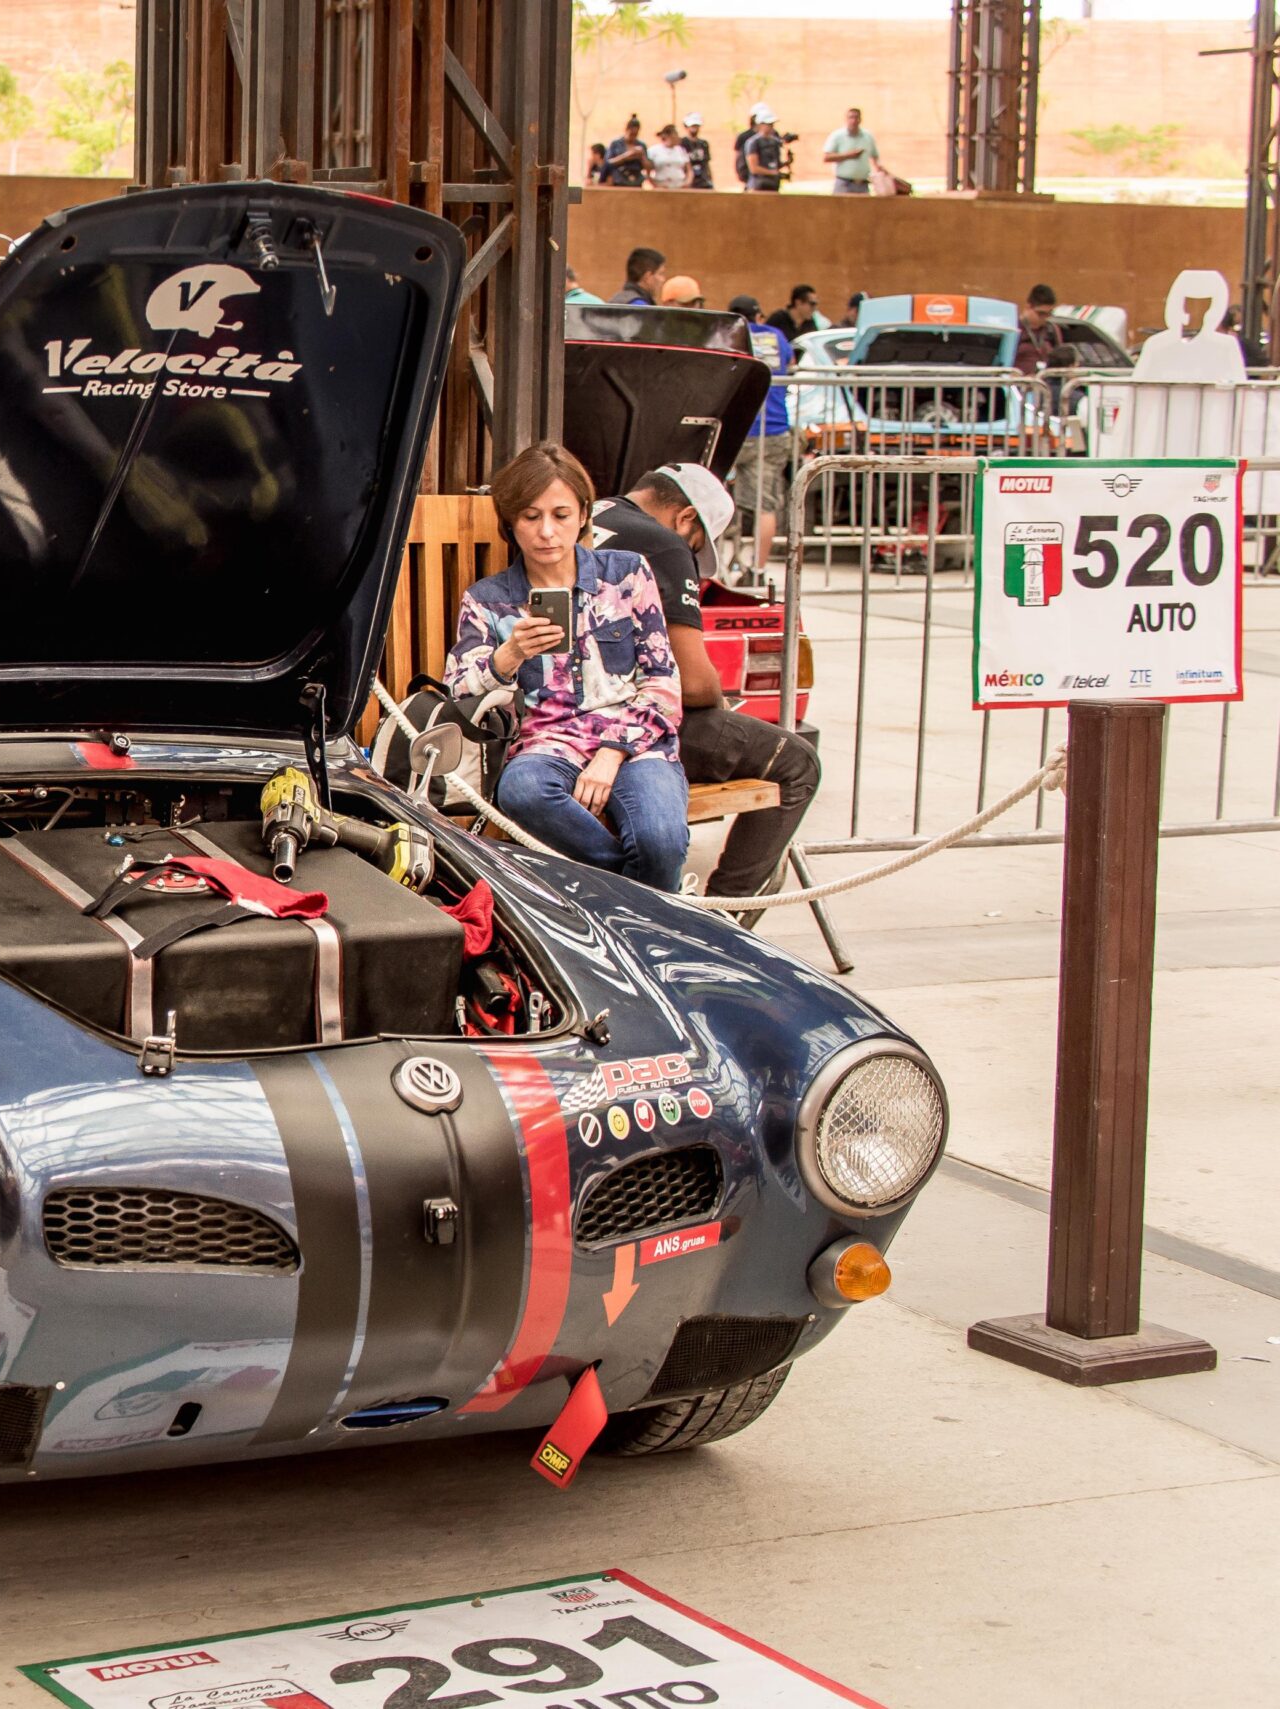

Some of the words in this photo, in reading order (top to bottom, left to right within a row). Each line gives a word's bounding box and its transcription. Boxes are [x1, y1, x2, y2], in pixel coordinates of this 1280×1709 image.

[178, 280, 217, 312] V
[82, 379, 156, 400] Racing
[162, 379, 228, 399] Store
[1000, 477, 1051, 492] MOTUL
[1072, 512, 1224, 589] 520
[715, 616, 781, 630] 2002
[1126, 602, 1196, 633] AUTO
[1072, 673, 1111, 689] telcel
[1129, 669, 1152, 684] ZTE
[1175, 669, 1224, 679] infinitum
[618, 1084, 647, 1095] PUEBLA
[650, 1080, 671, 1089] AUTO
[673, 1075, 693, 1085] CLUB
[691, 1098, 708, 1107] STOP
[542, 1447, 568, 1470] OMP
[353, 1626, 387, 1638] MINI
[100, 1653, 210, 1680] MOTUL
[329, 1615, 719, 1709] 291
[170, 1695, 195, 1706] La
[206, 1683, 276, 1699] Carrera
